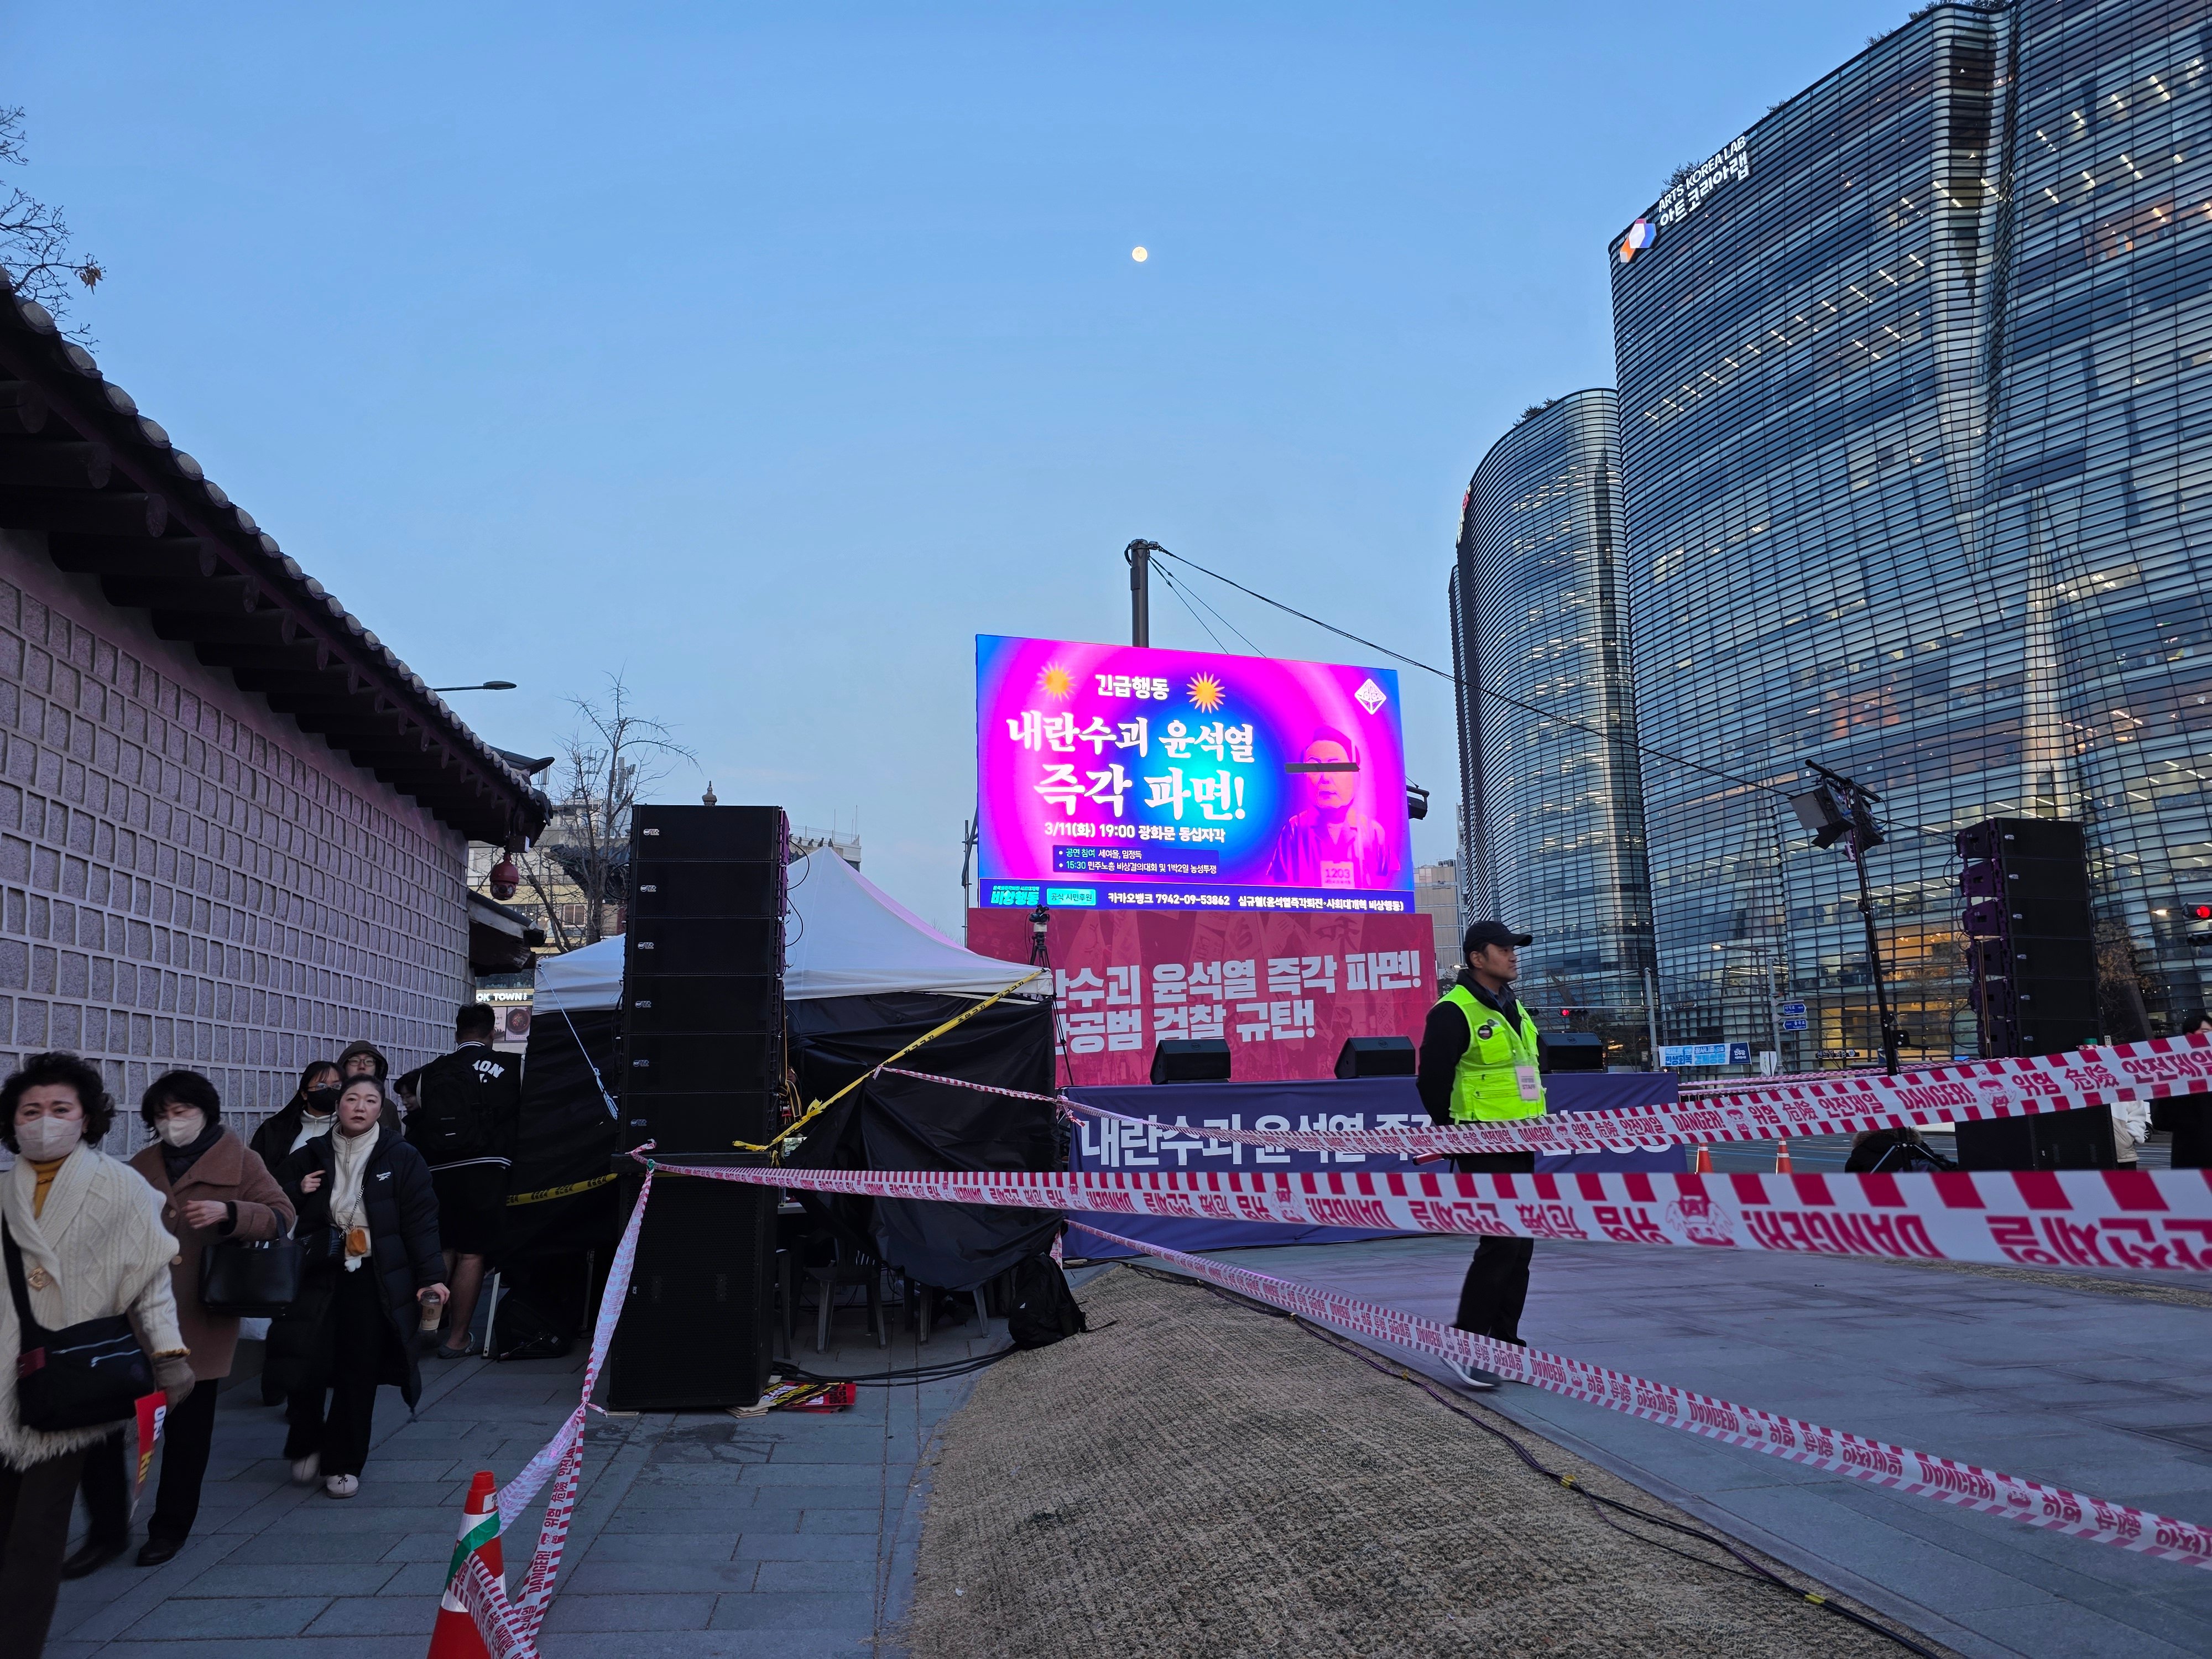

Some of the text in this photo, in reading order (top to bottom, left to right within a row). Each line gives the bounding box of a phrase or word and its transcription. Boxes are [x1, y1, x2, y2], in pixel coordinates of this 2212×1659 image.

[1658, 135, 1746, 213] ARTS KOREA LAB
[1660, 150, 1749, 226] 아트 코리아랩
[1095, 674, 1170, 700] 긴급행동
[1006, 710, 1255, 763] 내란수괴 윤석열
[1033, 763, 1246, 821] 즉각 파면!
[1045, 822, 1226, 843] 3/11(화) 19:00 광화문 동십자각
[1066, 848, 1080, 858] 공연
[1081, 848, 1095, 858] 참여
[1122, 851, 1142, 859] 임정득
[1066, 860, 1217, 874] 15:30 민주노총 비상결의대회 및 1박2일 농성투쟁
[1326, 868, 1350, 878] 1203
[991, 890, 1039, 906] 비상행동
[1108, 892, 1154, 905] 카카오뱅크
[1155, 894, 1230, 906] 7942-09-53862
[1368, 900, 1404, 912] 비상행동)
[1152, 959, 1257, 1003] 윤석열
[1267, 954, 1337, 995] 즉각
[1345, 950, 1421, 992] 파면!
[476, 993, 490, 1001] OK
[493, 993, 523, 1001] TOWN
[1154, 1003, 1226, 1040] 검찰
[1236, 1000, 1315, 1042] 규탄!
[1379, 1134, 1406, 1148] 안전제일
[1406, 1135, 1434, 1148] DANGER!
[1446, 1133, 1460, 1146] 위험
[1463, 1132, 1481, 1145] 危險
[1480, 1128, 1515, 1144] 안전제일
[1517, 1125, 1556, 1144] DANGER!
[1572, 1123, 1593, 1140] 위험
[1595, 1121, 1620, 1138] 危險
[1621, 1115, 1666, 1136] 안전제일
[1670, 1110, 1725, 1132] DANGER!
[1748, 1105, 1781, 1125] 위험
[1782, 1100, 1819, 1122] 危險
[1818, 1092, 1886, 1119] 안전제일
[1893, 1082, 1977, 1110] DANGER!
[2012, 1071, 2061, 1097] 위험
[2064, 1064, 2120, 1092] 危險
[2121, 1050, 2212, 1084] 안전제일
[1081, 1113, 1241, 1167] 내란수괴
[1255, 1113, 1366, 1164] 윤석열
[1143, 1192, 1196, 1217] 안전제일
[1237, 1196, 1280, 1222] 위험
[1305, 1198, 1398, 1229] DANGER!
[1408, 1201, 1518, 1235] 안전제일
[1515, 1204, 1588, 1239] 危險
[1592, 1206, 1673, 1244] 위험
[1740, 1211, 1948, 1259] DANGER!
[551, 1481, 568, 1503] 危險
[544, 1509, 561, 1527] 위험
[527, 1551, 551, 1594] DANGER!
